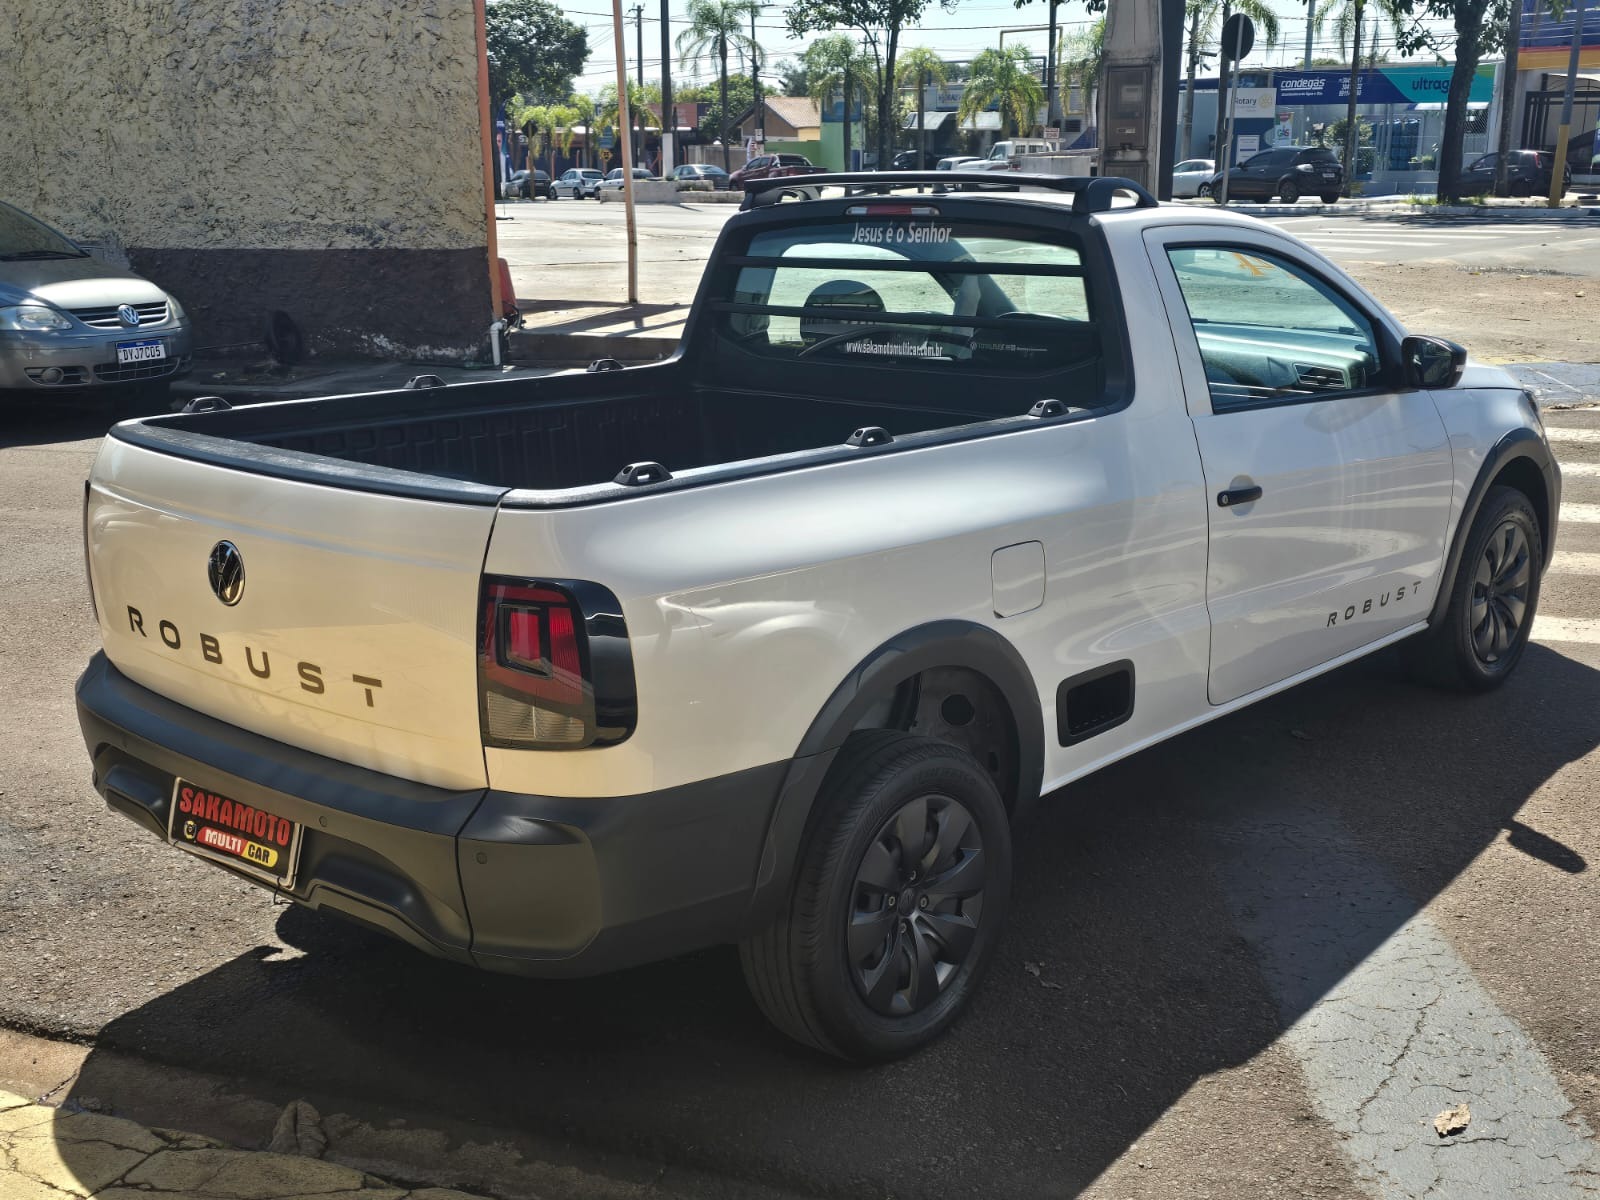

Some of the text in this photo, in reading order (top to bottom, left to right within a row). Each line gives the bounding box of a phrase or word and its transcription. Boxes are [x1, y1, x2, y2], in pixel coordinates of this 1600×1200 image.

[1412, 77, 1450, 94] ultrag
[852, 221, 952, 243] Jesus é o Senhor
[1326, 580, 1422, 627] ROBUST
[127, 605, 382, 708] ROBUST
[179, 787, 291, 847] SAKAMOTO
[204, 828, 270, 864] MULTI CAR
